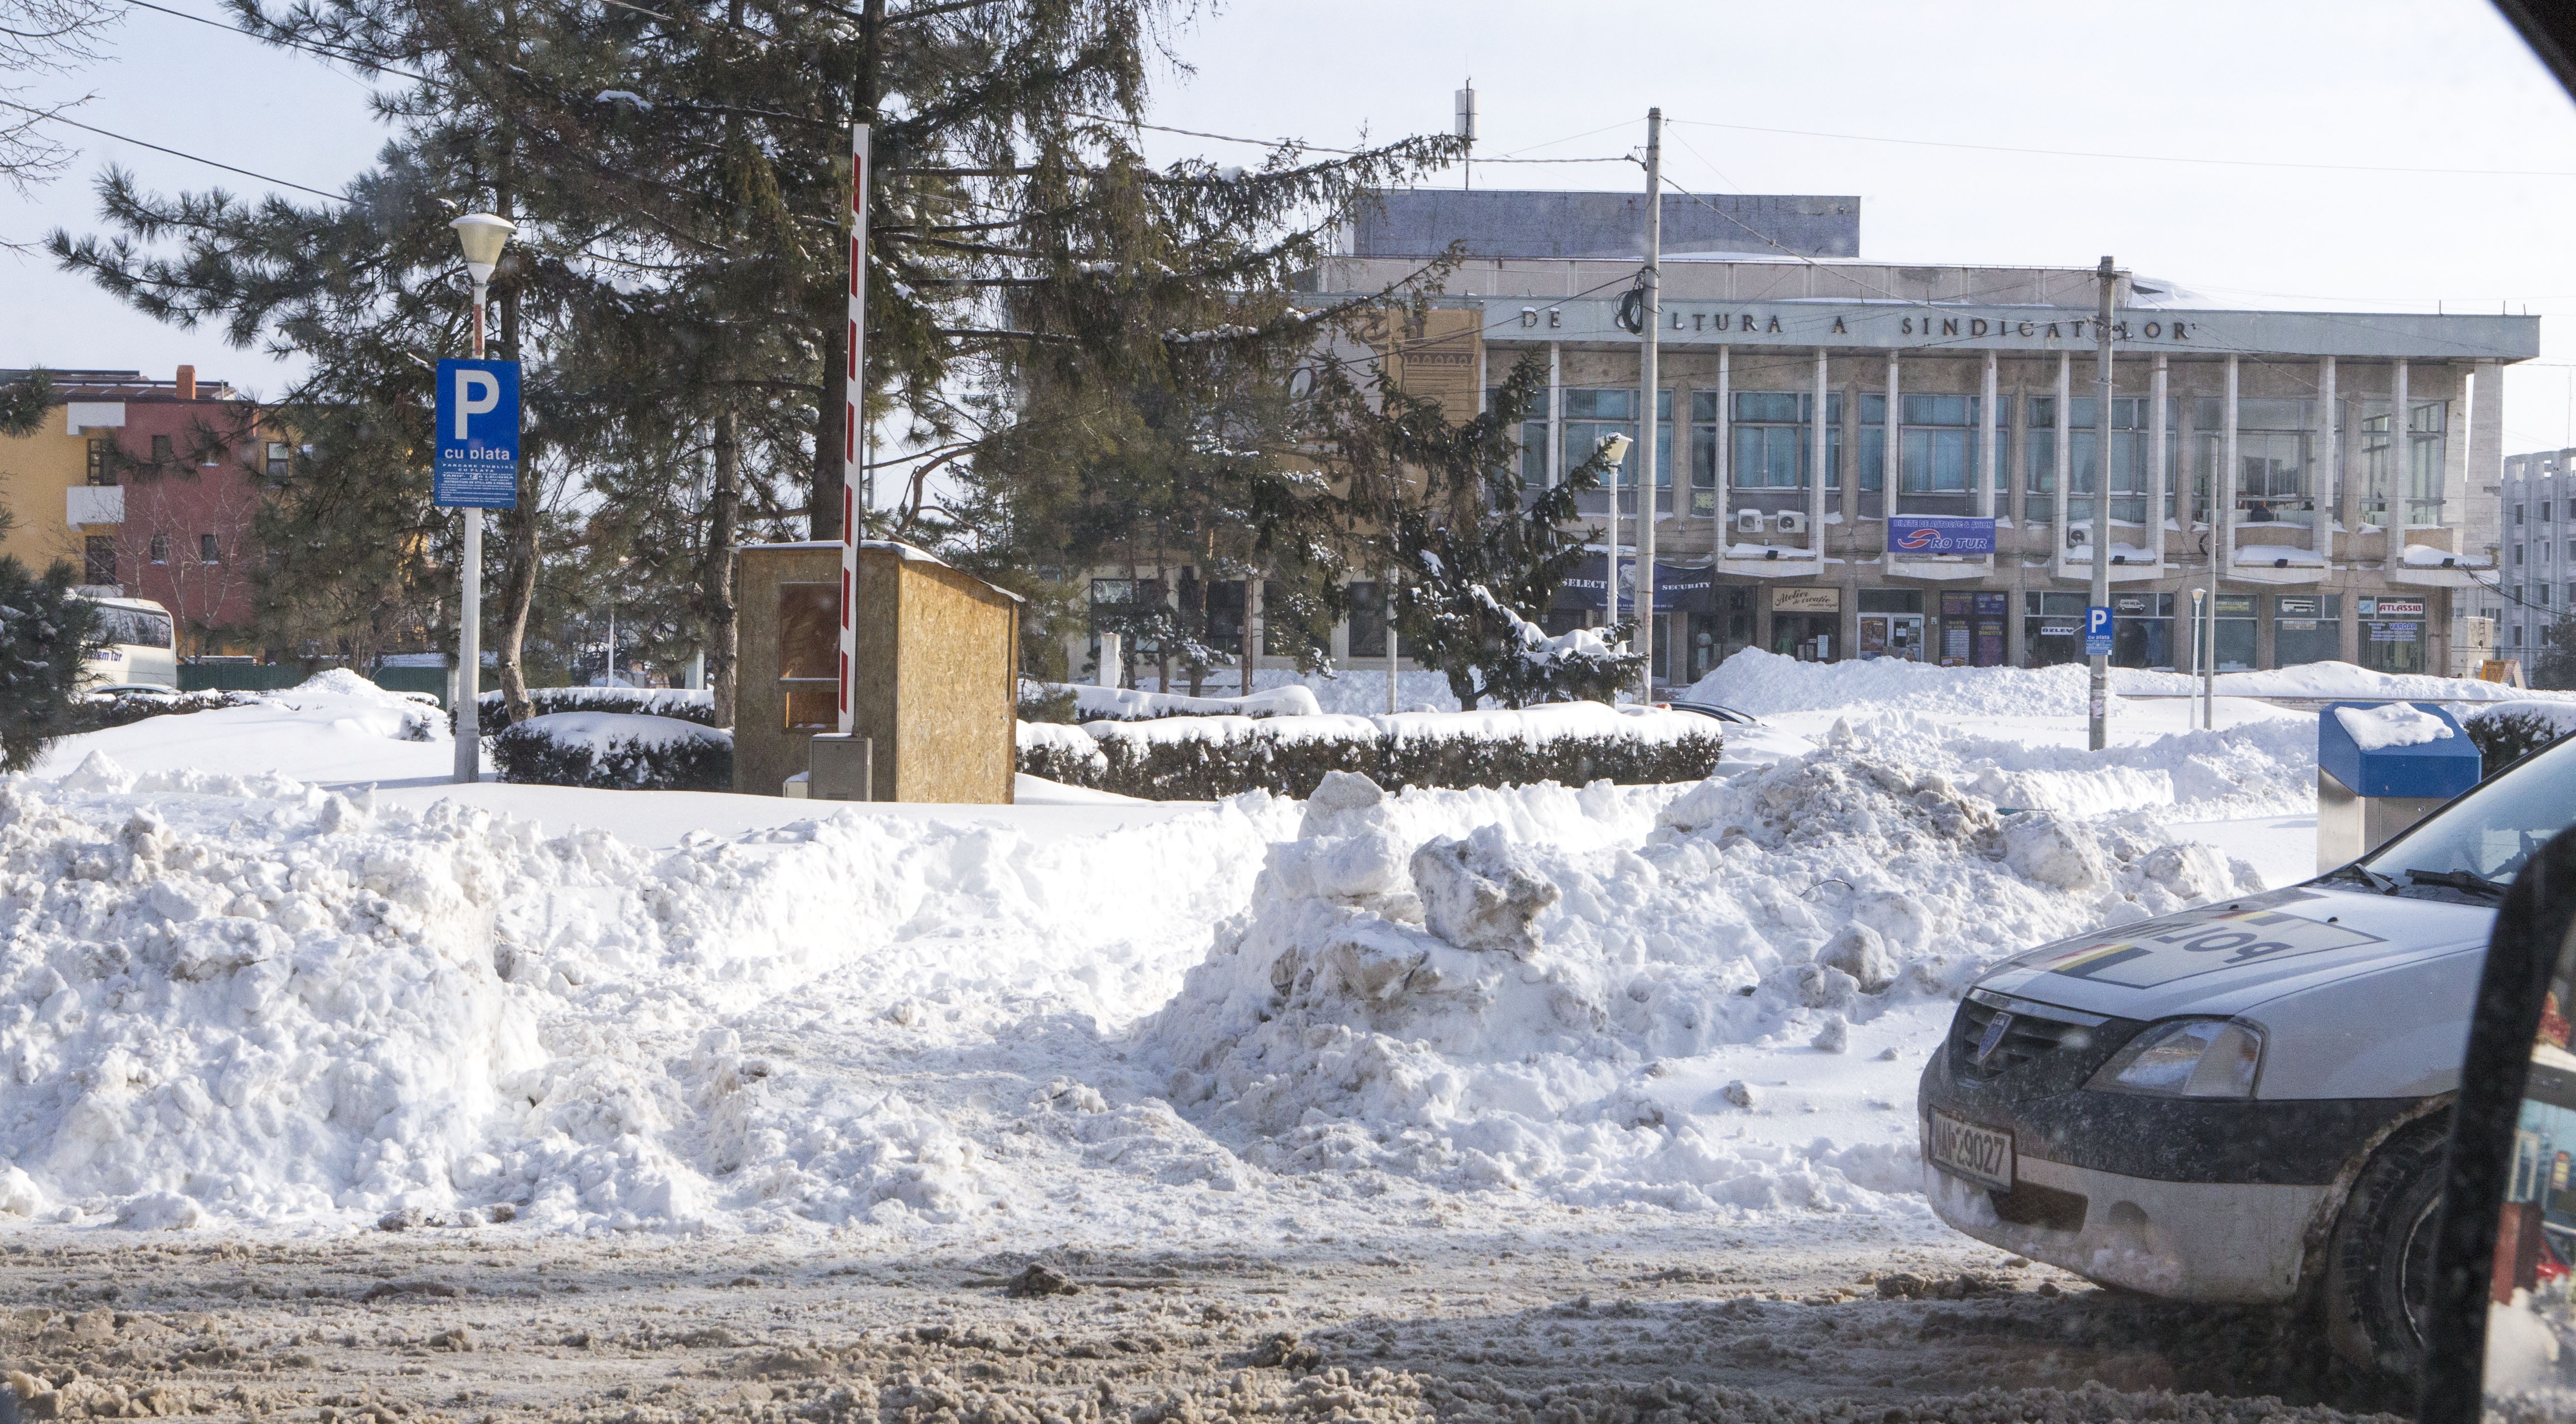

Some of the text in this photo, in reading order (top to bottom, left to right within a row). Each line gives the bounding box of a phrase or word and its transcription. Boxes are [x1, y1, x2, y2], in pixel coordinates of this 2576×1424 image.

[1521, 309, 2190, 339] DE LTURA A SINDICATLOR
[455, 369, 500, 440] P
[444, 447, 510, 460] cu plata
[1970, 521, 1993, 529] AVION
[1956, 538, 1987, 549] TUR
[1562, 578, 1711, 591] SELECT SECURITY
[1775, 589, 1808, 606] Atelier
[2091, 610, 2107, 633] P
